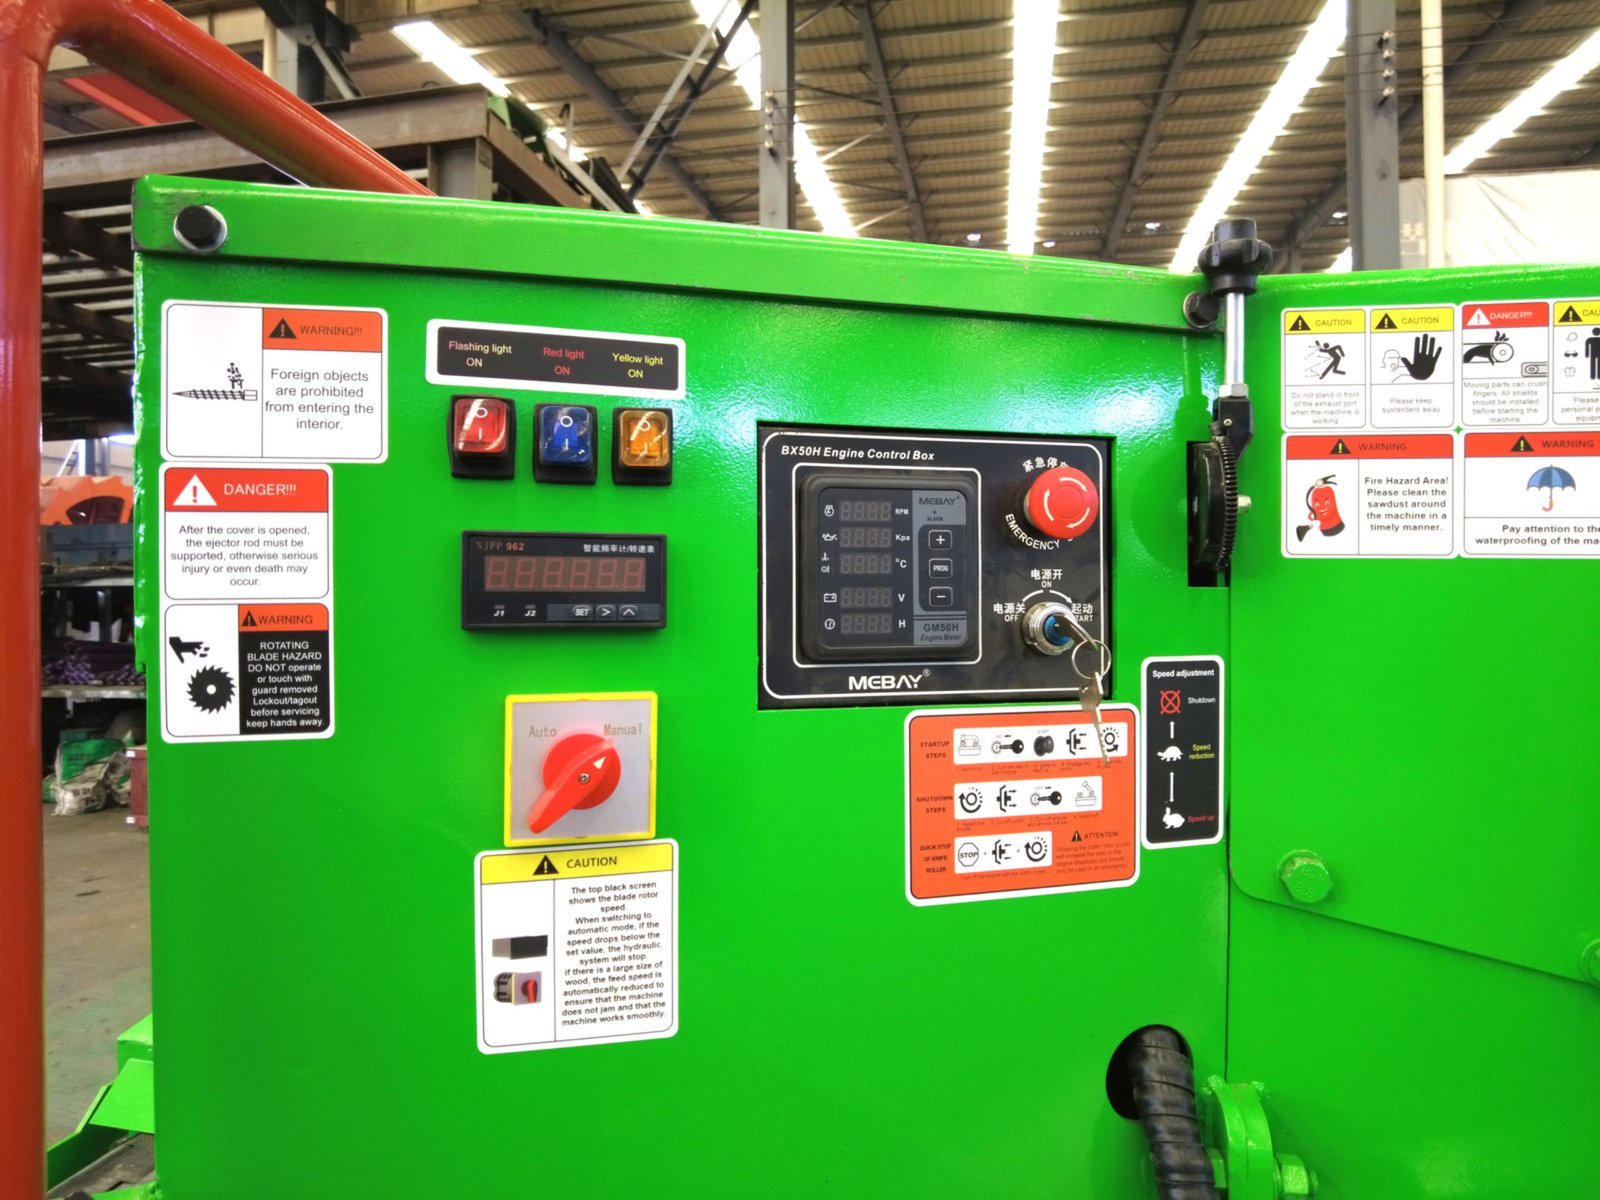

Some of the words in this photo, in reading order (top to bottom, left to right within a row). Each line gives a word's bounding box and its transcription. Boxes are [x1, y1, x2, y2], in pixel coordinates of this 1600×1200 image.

[1315, 319, 1352, 327] CAUTION
[1401, 317, 1439, 325] CAUTION
[449, 341, 490, 354] Flashing
[492, 344, 512, 355] light
[543, 347, 563, 357] Red
[565, 349, 585, 360] light
[466, 358, 483, 367] ON
[612, 353, 643, 363] Yellow
[644, 355, 663, 366] light
[554, 366, 570, 375] ON
[628, 369, 643, 378] ON
[271, 368, 320, 383] Foreign
[324, 371, 369, 383] objects
[276, 387, 297, 396] are
[301, 386, 364, 398] prohibited
[265, 401, 294, 412] from
[298, 403, 350, 416] entering
[354, 404, 374, 414] the
[296, 419, 343, 429] interior.
[1358, 443, 1407, 451] WARNING
[1542, 440, 1594, 448] WARNING
[781, 445, 821, 456] BX50H
[823, 447, 865, 460] Engine
[867, 449, 911, 460] Control
[912, 450, 935, 460] Box
[1365, 477, 1383, 485] Fire
[1386, 477, 1420, 485] Hazard
[1367, 488, 1399, 496] Please
[1411, 500, 1446, 508] around
[1366, 512, 1382, 520] the
[1384, 512, 1426, 520] machine
[179, 525, 204, 534] After
[207, 526, 224, 534] the
[269, 527, 310, 536] opened,
[1005, 513, 1060, 550] EMERGENCY
[1370, 524, 1400, 532] timely
[1502, 525, 1521, 534] Pay
[895, 534, 910, 542] Kpa
[1475, 537, 1547, 546] waterproofing
[1550, 537, 1561, 545] of
[1564, 537, 1580, 545] the
[186, 539, 203, 547] the
[205, 539, 241, 549] ejector
[244, 539, 260, 547] rod
[263, 539, 288, 547] must
[291, 539, 304, 547] be
[506, 542, 525, 551] 962
[170, 552, 226, 562] supported,
[229, 552, 279, 560] otherwise
[282, 552, 318, 560] serious
[182, 565, 210, 575] injury
[254, 564, 284, 573] death
[286, 566, 308, 574] may
[1031, 569, 1063, 580] 电源开
[1041, 580, 1052, 588] ON
[898, 594, 905, 602] V
[574, 607, 589, 616] SET
[993, 602, 1026, 615] 电源关
[1071, 603, 1093, 614] 起动
[258, 615, 313, 625] WARNING
[1004, 613, 1019, 622] OFF
[899, 620, 906, 628] H
[923, 623, 959, 632] GM50H
[920, 634, 943, 642] Engine
[260, 641, 309, 650] ROTATING
[247, 653, 279, 662] BLADE
[282, 652, 322, 661] HAZARD
[248, 664, 263, 673] DO
[265, 663, 286, 672] NOT
[288, 664, 322, 672] operate
[268, 675, 293, 683] touch
[294, 674, 313, 682] with
[1152, 670, 1175, 679] Speed
[1176, 670, 1215, 678] adjustment
[252, 686, 278, 696] guard
[280, 685, 318, 694] removed
[253, 696, 317, 706] Lockout/tagout
[250, 708, 279, 717] before
[281, 708, 320, 716] servicing
[246, 720, 268, 728] keep
[270, 719, 297, 727] hands
[299, 719, 324, 727] away.
[528, 726, 557, 738] Auto
[604, 724, 642, 736] Manual
[1192, 744, 1211, 752] Speed
[1187, 815, 1207, 823] Speed
[959, 851, 978, 860] STOP
[566, 856, 617, 868] CAUTION
[604, 884, 626, 892] black
[629, 882, 656, 890] screen
[569, 897, 596, 905] shows
[614, 893, 636, 901] blade
[602, 914, 642, 922] switching
[568, 926, 609, 935] automatic
[567, 938, 592, 947] speed
[594, 936, 619, 944] drops
